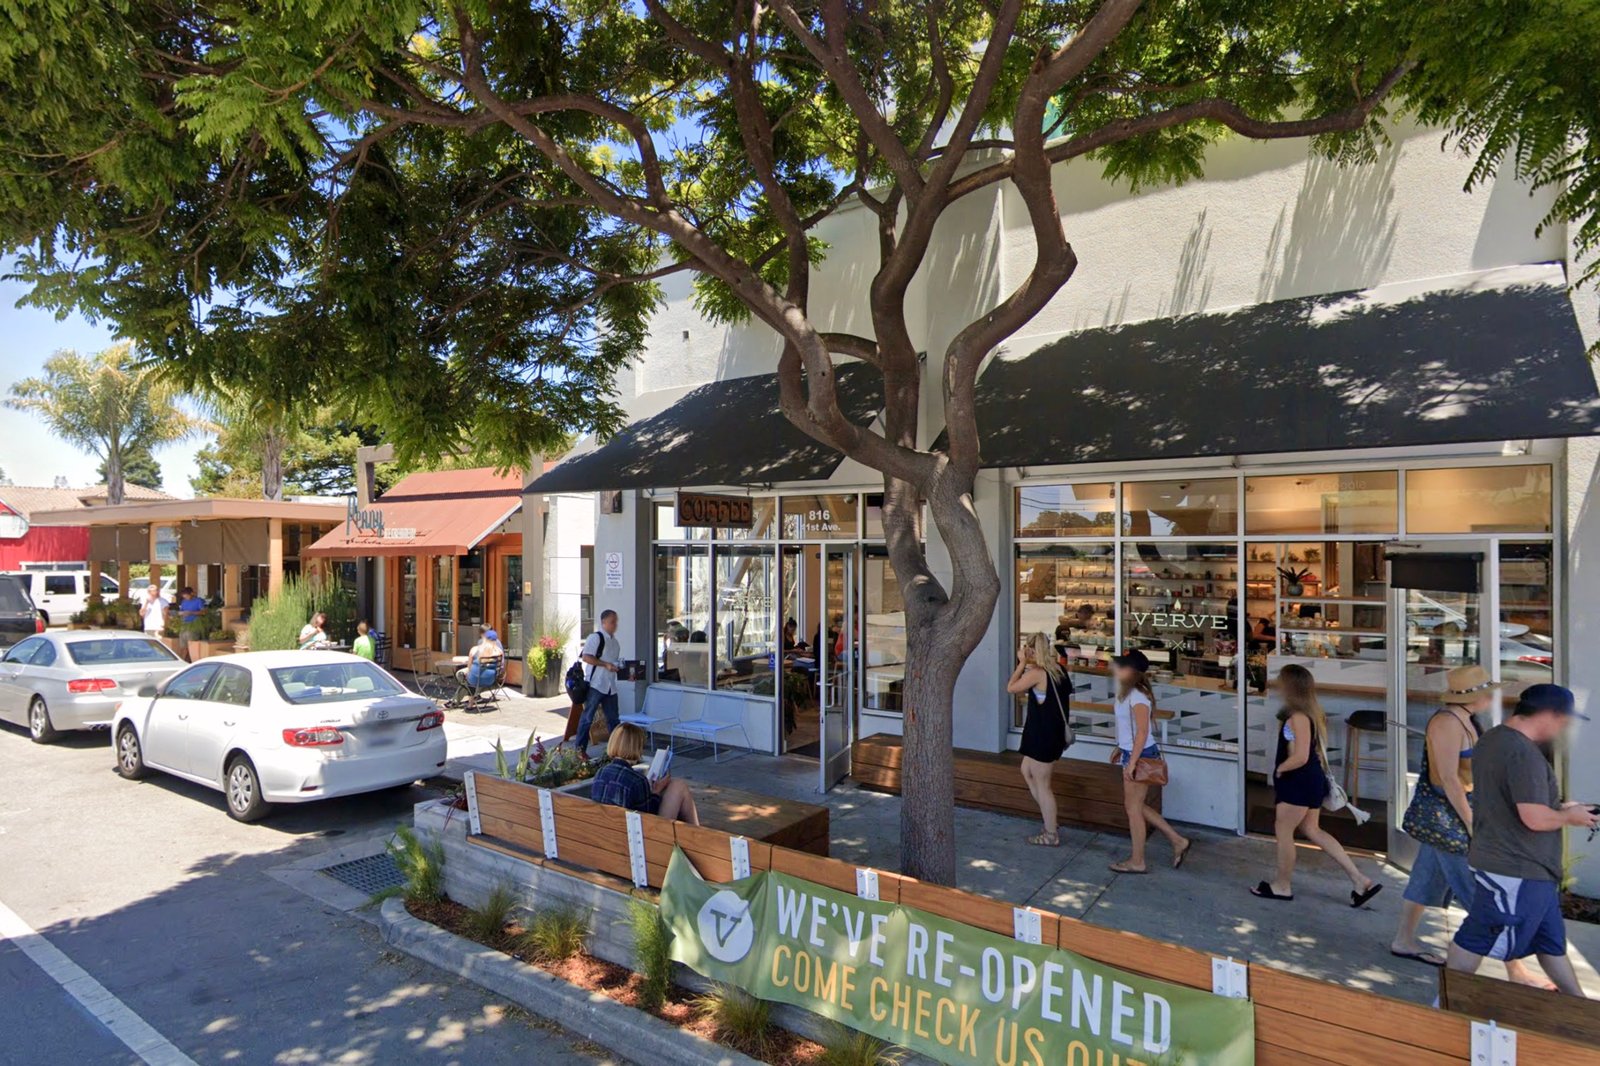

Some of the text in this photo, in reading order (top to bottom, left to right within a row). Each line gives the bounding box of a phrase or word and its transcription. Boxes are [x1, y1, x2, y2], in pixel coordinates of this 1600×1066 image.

[680, 498, 751, 524] COFFEE
[808, 509, 831, 521] 816
[821, 522, 842, 532] Ave.
[1130, 611, 1229, 630] VERVE
[776, 885, 1172, 1055] WE'VE RE-OPENED
[771, 944, 1045, 1066] COME CHECK US
